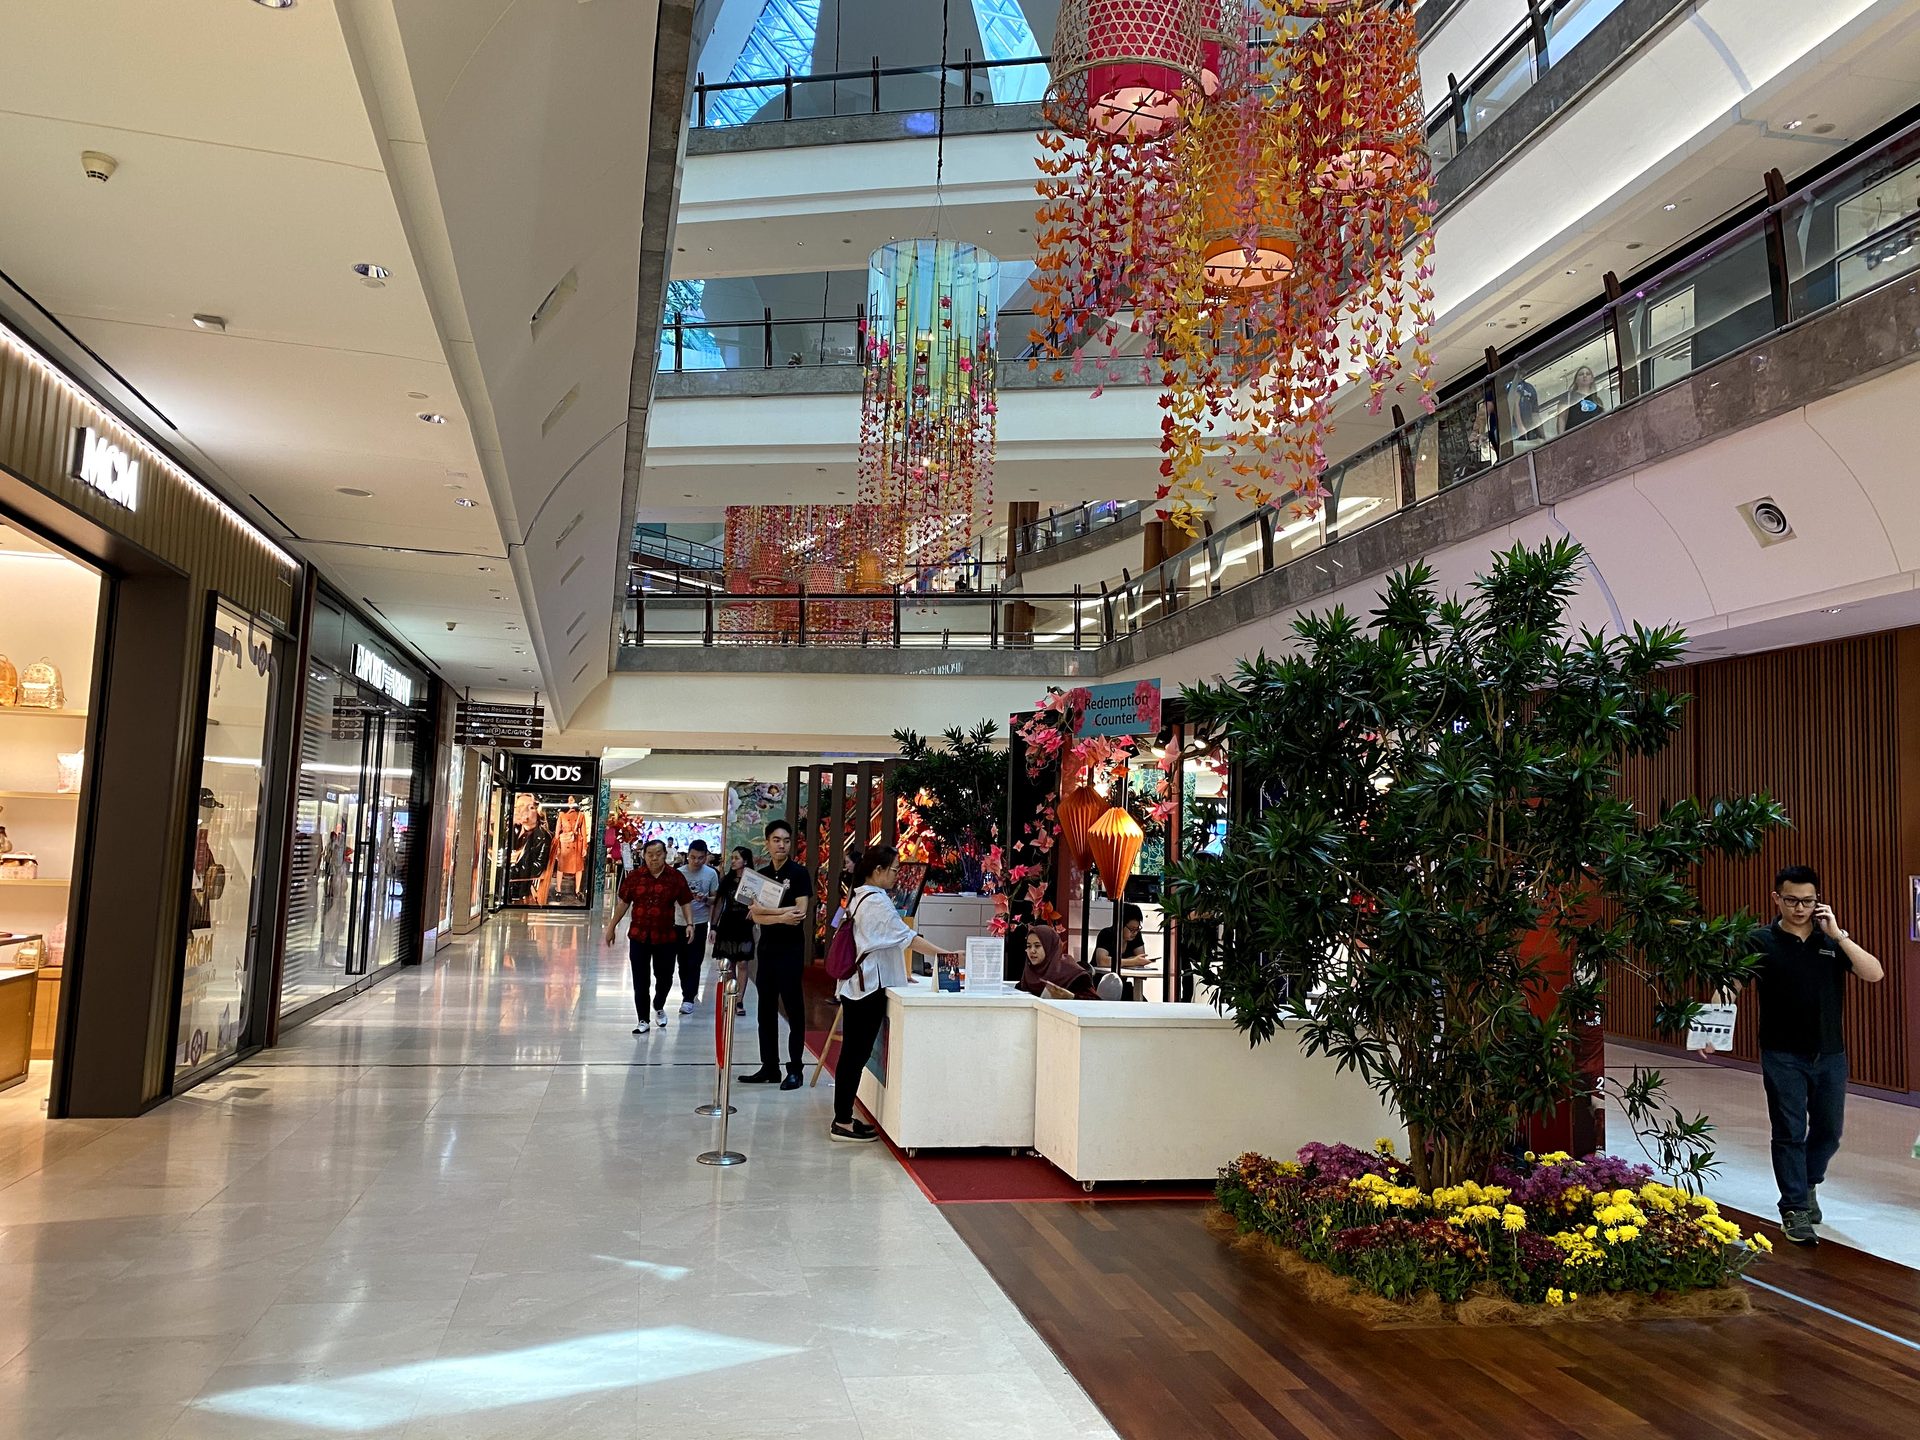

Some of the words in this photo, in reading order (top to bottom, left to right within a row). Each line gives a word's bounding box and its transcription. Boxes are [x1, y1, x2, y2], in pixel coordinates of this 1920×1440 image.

[80, 426, 139, 513] MCM
[1084, 692, 1149, 711] Redemption
[491, 706, 522, 714] Residences
[495, 717, 520, 725] Entrance
[1094, 713, 1138, 727] Counter
[531, 763, 582, 782] TOD'S
